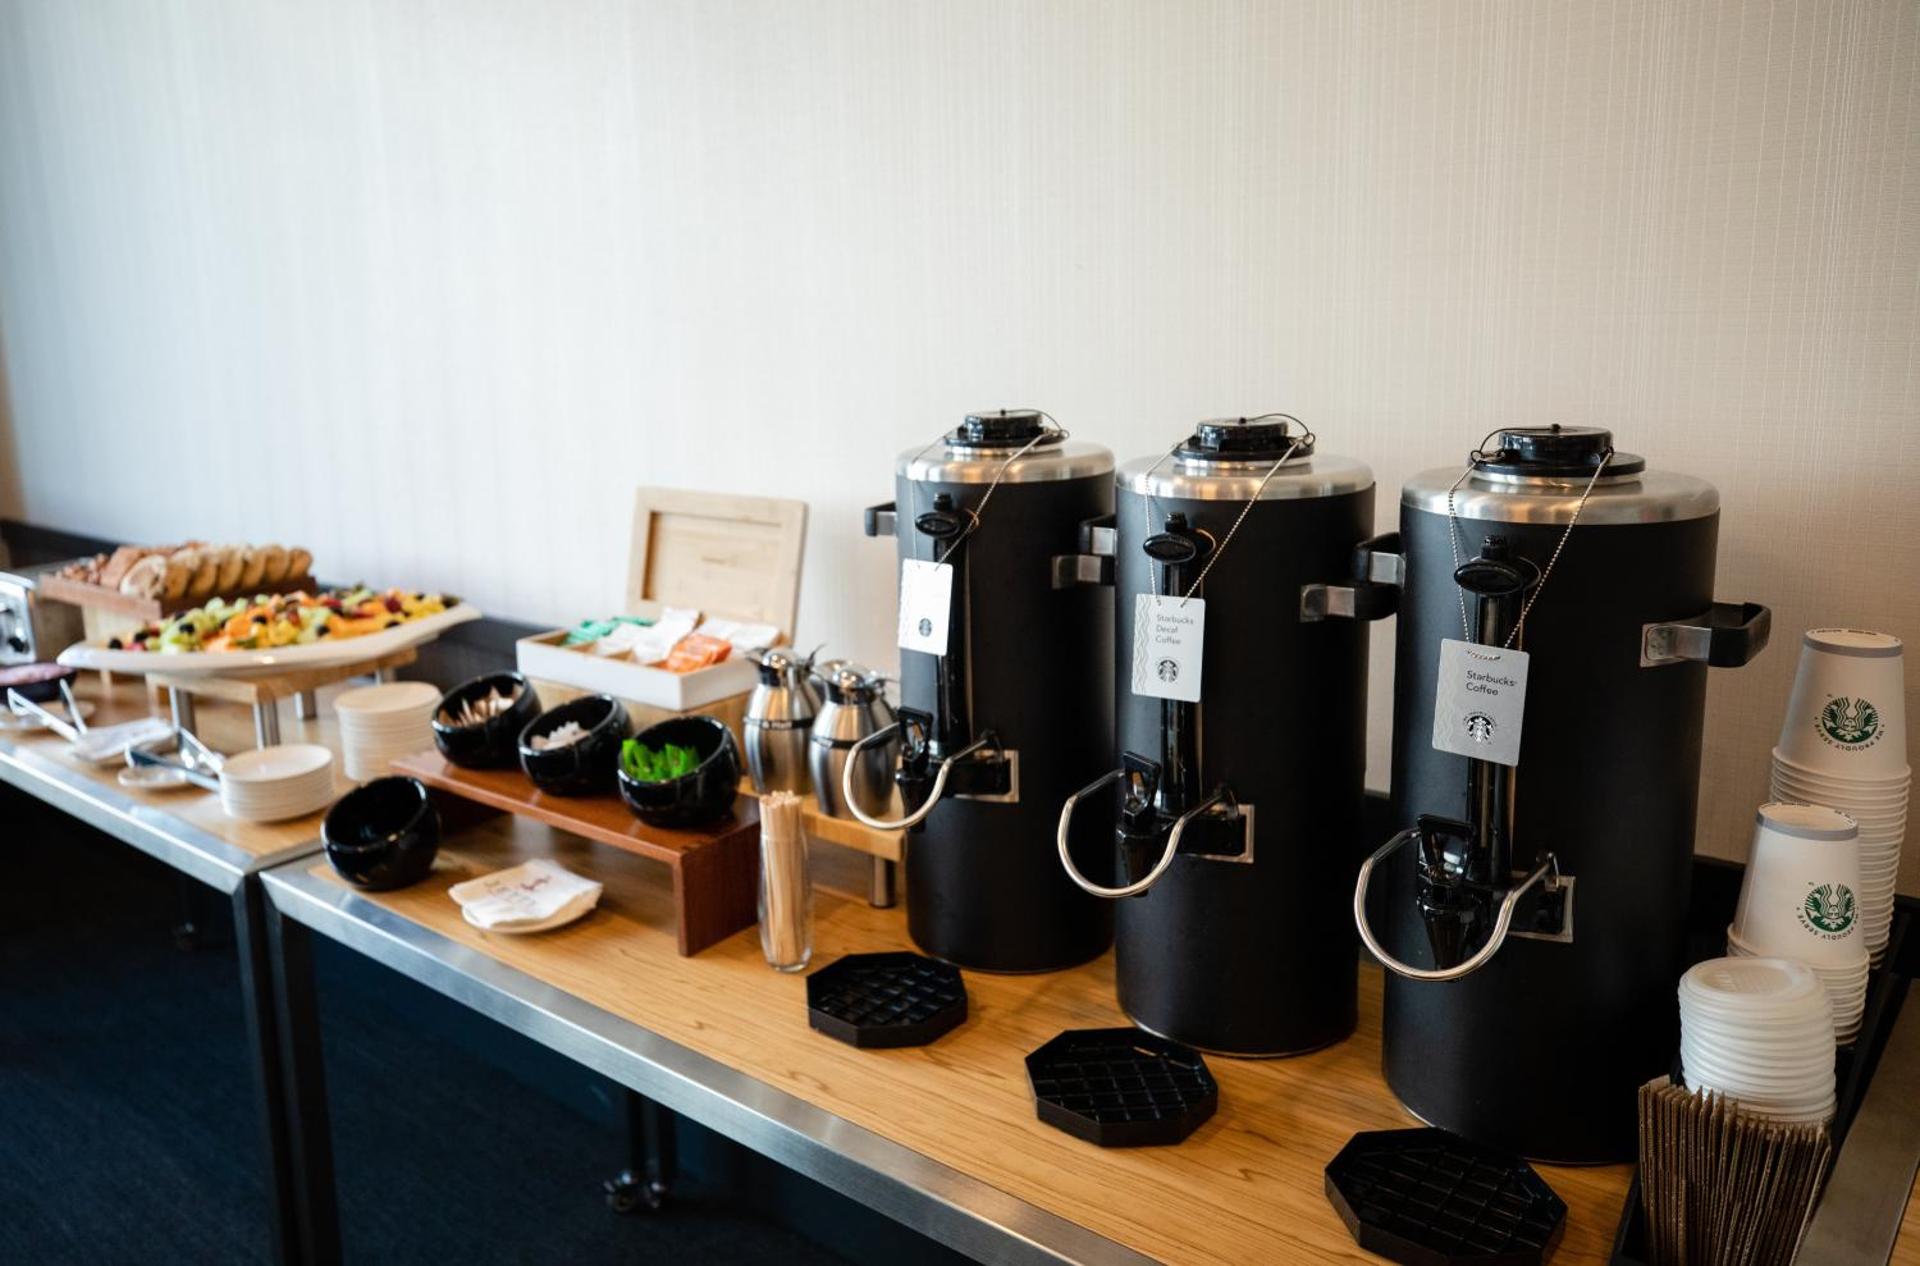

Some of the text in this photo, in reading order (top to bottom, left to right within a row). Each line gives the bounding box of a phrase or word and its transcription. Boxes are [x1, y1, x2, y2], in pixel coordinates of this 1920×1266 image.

[1157, 614, 1194, 625] Starbucks
[1156, 625, 1178, 634] Decaf
[1155, 635, 1182, 645] Coffee
[1466, 670, 1515, 687] Starbucks
[1466, 682, 1499, 696] Coffee
